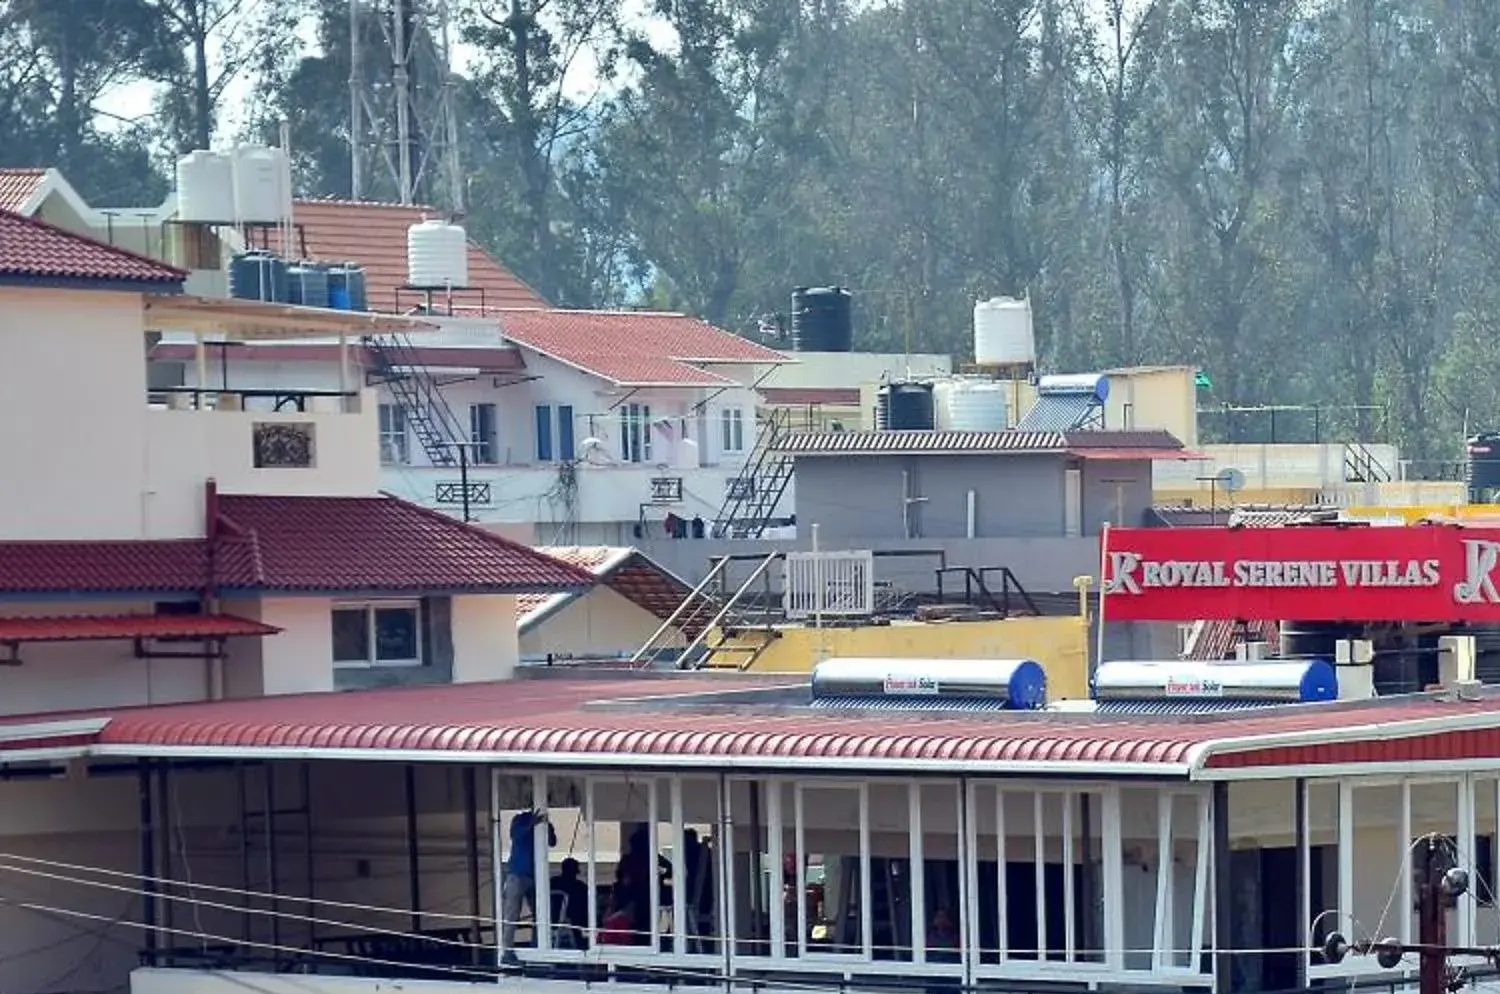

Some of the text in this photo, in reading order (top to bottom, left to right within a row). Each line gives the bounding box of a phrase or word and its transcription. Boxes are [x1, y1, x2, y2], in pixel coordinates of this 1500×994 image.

[1142, 560, 1231, 588] ROYAL
[1233, 559, 1338, 588] SERENE
[1339, 558, 1442, 587] VILLAS
